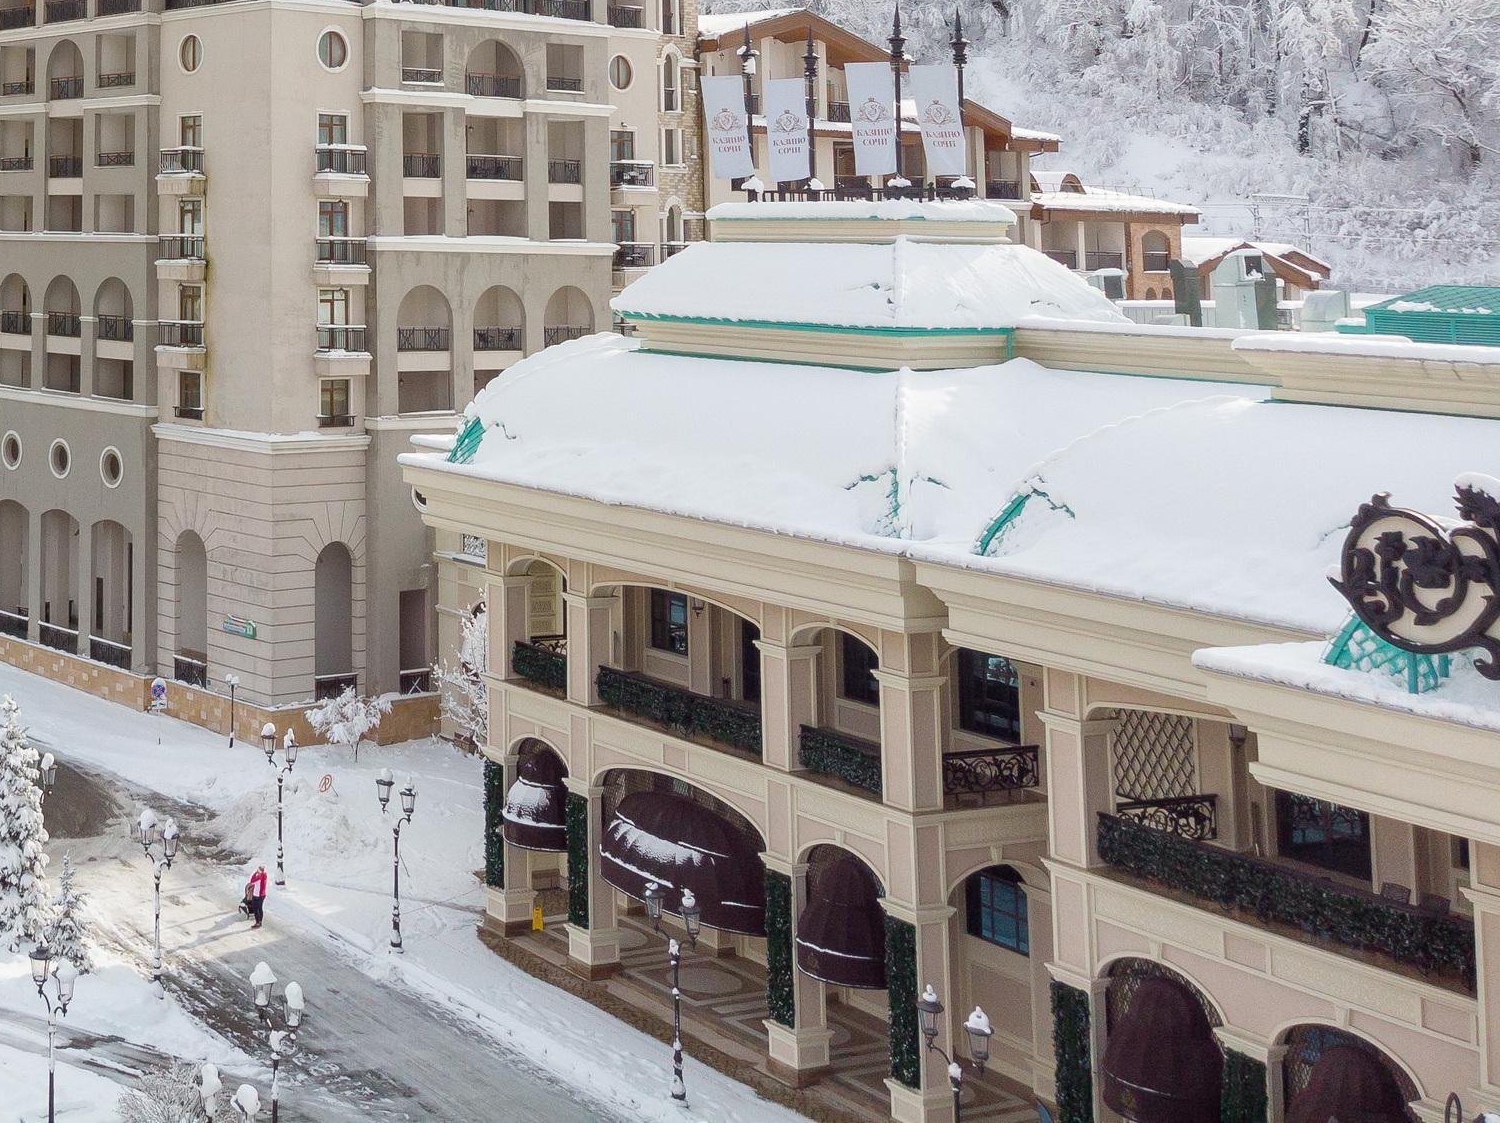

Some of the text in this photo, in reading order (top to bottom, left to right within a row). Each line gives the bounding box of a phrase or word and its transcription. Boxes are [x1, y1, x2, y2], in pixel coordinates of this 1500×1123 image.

[925, 130, 961, 139] КАЗИНО
[712, 135, 746, 145] КАЗИНО
[772, 136, 806, 147] КАЗИНО
[862, 138, 888, 147] СОЧИ
[932, 139, 957, 148] СОЧИ
[718, 145, 741, 154] СОЧИ
[778, 146, 801, 155] СОЧИ
